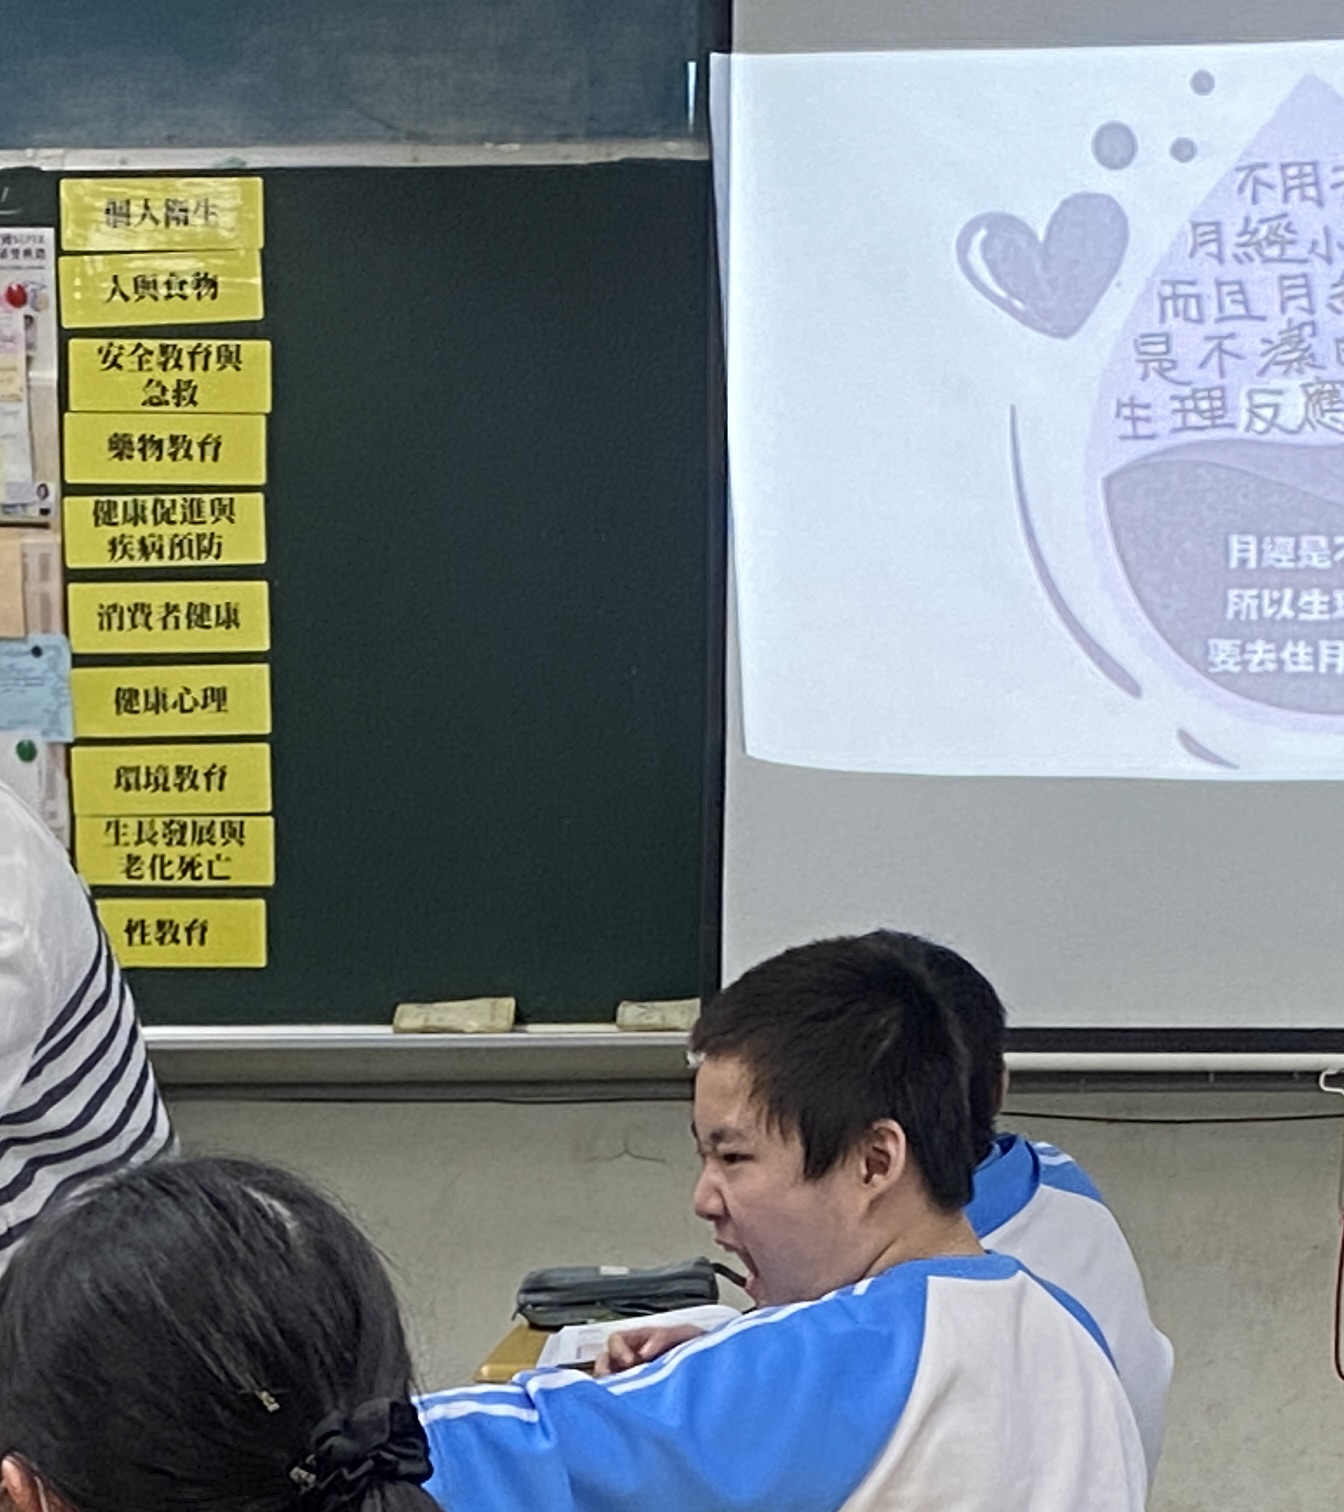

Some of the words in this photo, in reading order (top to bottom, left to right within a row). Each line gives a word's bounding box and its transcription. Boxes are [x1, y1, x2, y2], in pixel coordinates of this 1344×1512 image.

[108, 271, 220, 304] 人與食物
[98, 343, 242, 372] 安全教育與
[141, 379, 199, 408] 急救
[107, 432, 223, 463] 藥物教育
[93, 497, 236, 527] 健康促進與
[107, 532, 223, 562] 疾病預防
[98, 603, 241, 632] 消費者健康
[114, 686, 229, 716] 健康心理
[114, 765, 228, 794] 環境教育
[104, 819, 246, 848] 生長發展與
[119, 853, 232, 883] 老化死亡
[123, 919, 209, 948] 性教育
